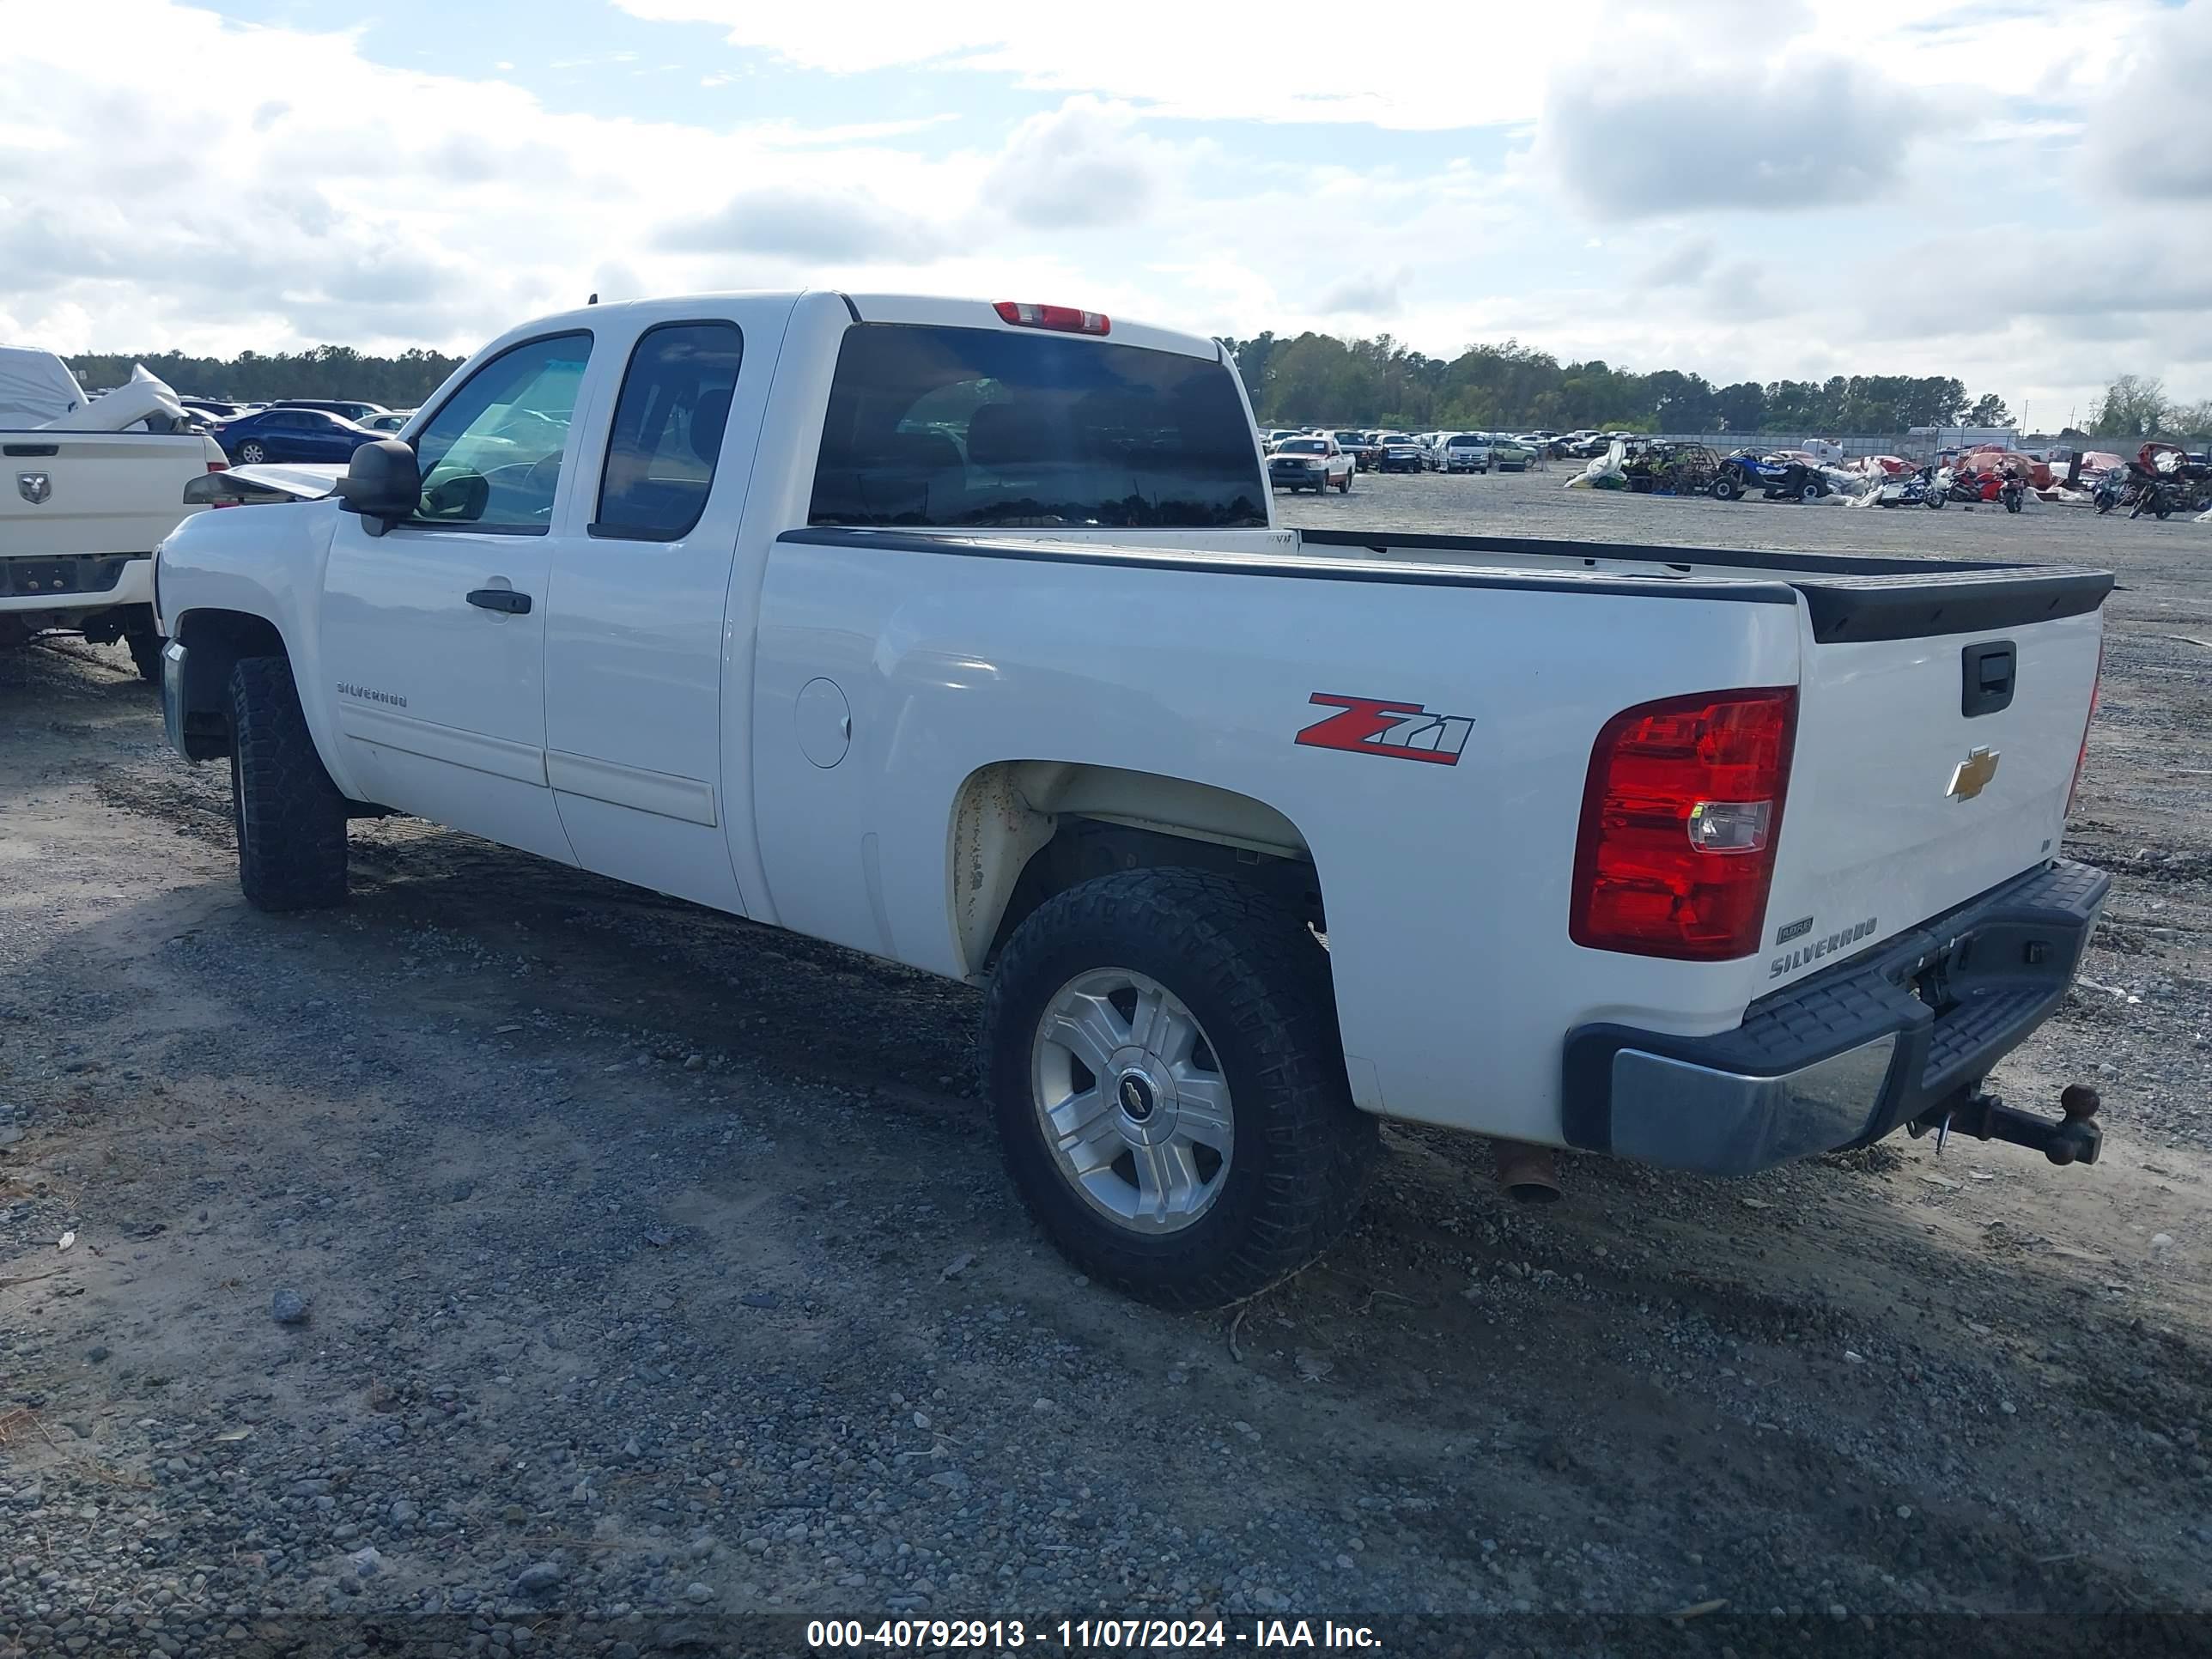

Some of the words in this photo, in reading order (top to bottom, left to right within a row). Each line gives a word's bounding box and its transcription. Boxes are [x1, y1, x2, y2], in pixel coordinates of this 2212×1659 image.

[337, 681, 407, 708] SILVERADO
[1294, 692, 1476, 766] Z71
[1769, 917, 1877, 979] SILVERADO
